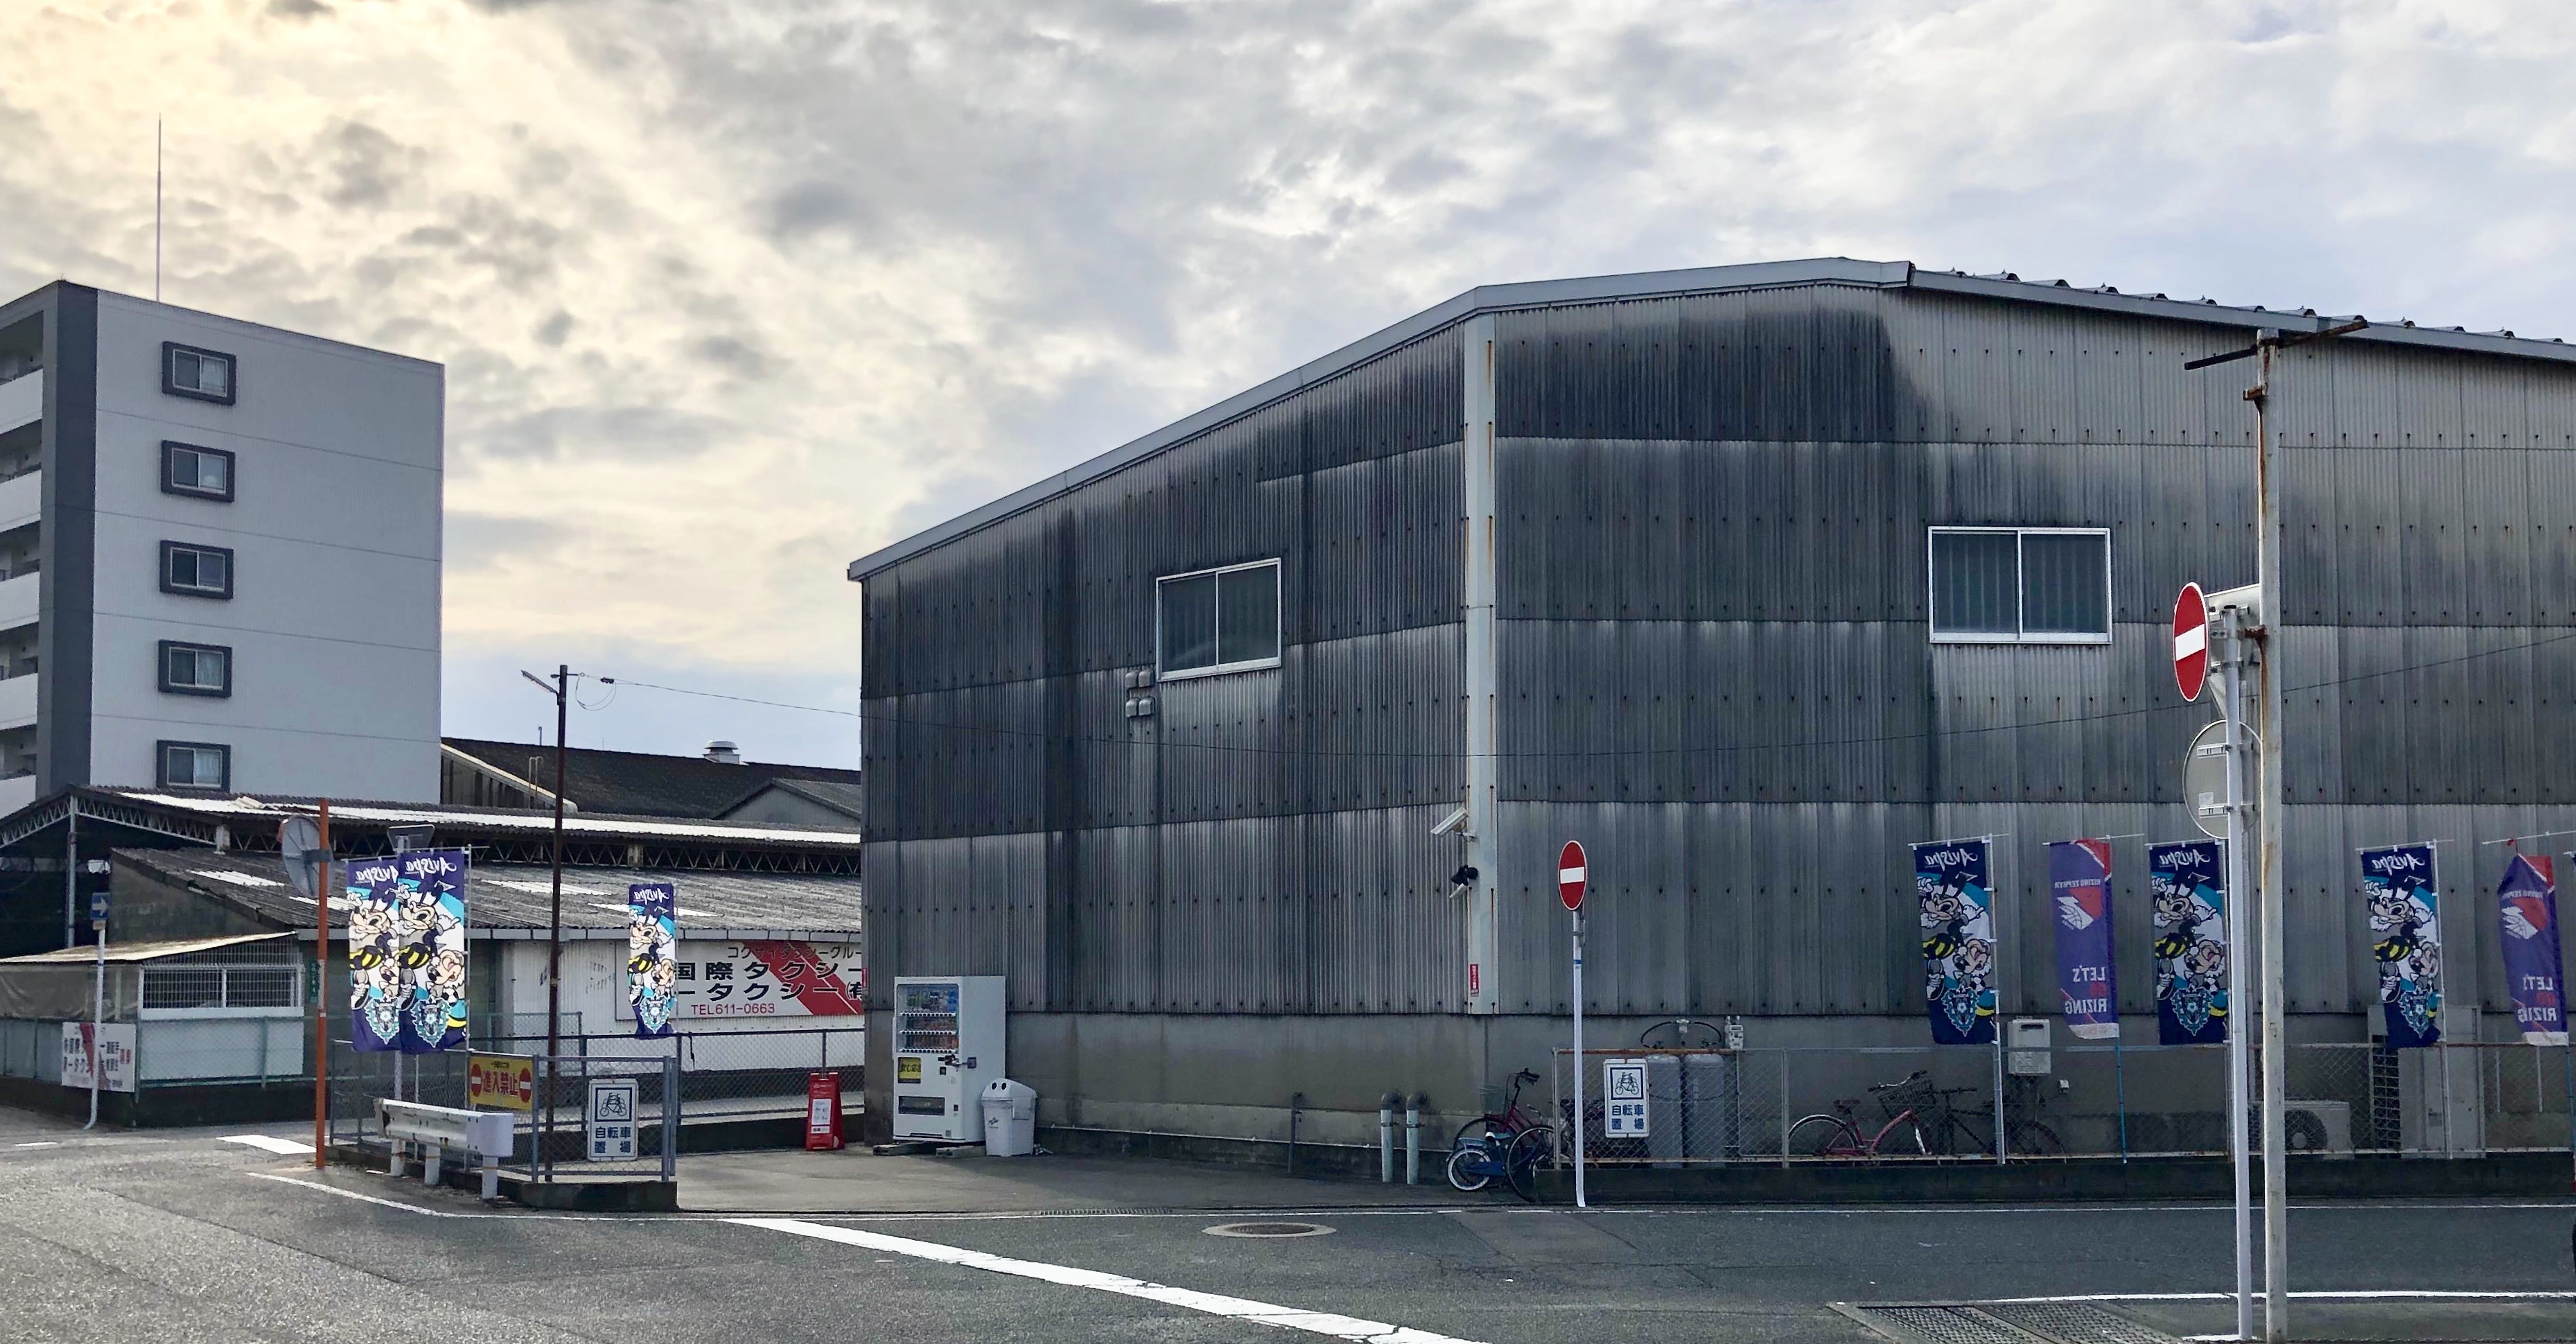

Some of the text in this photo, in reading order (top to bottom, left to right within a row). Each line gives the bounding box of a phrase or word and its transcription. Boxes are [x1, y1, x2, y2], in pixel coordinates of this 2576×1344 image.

[483, 1070, 518, 1096] 進入禁止
[1612, 1104, 1644, 1116] 自転車
[595, 1126, 631, 1139] 自転車
